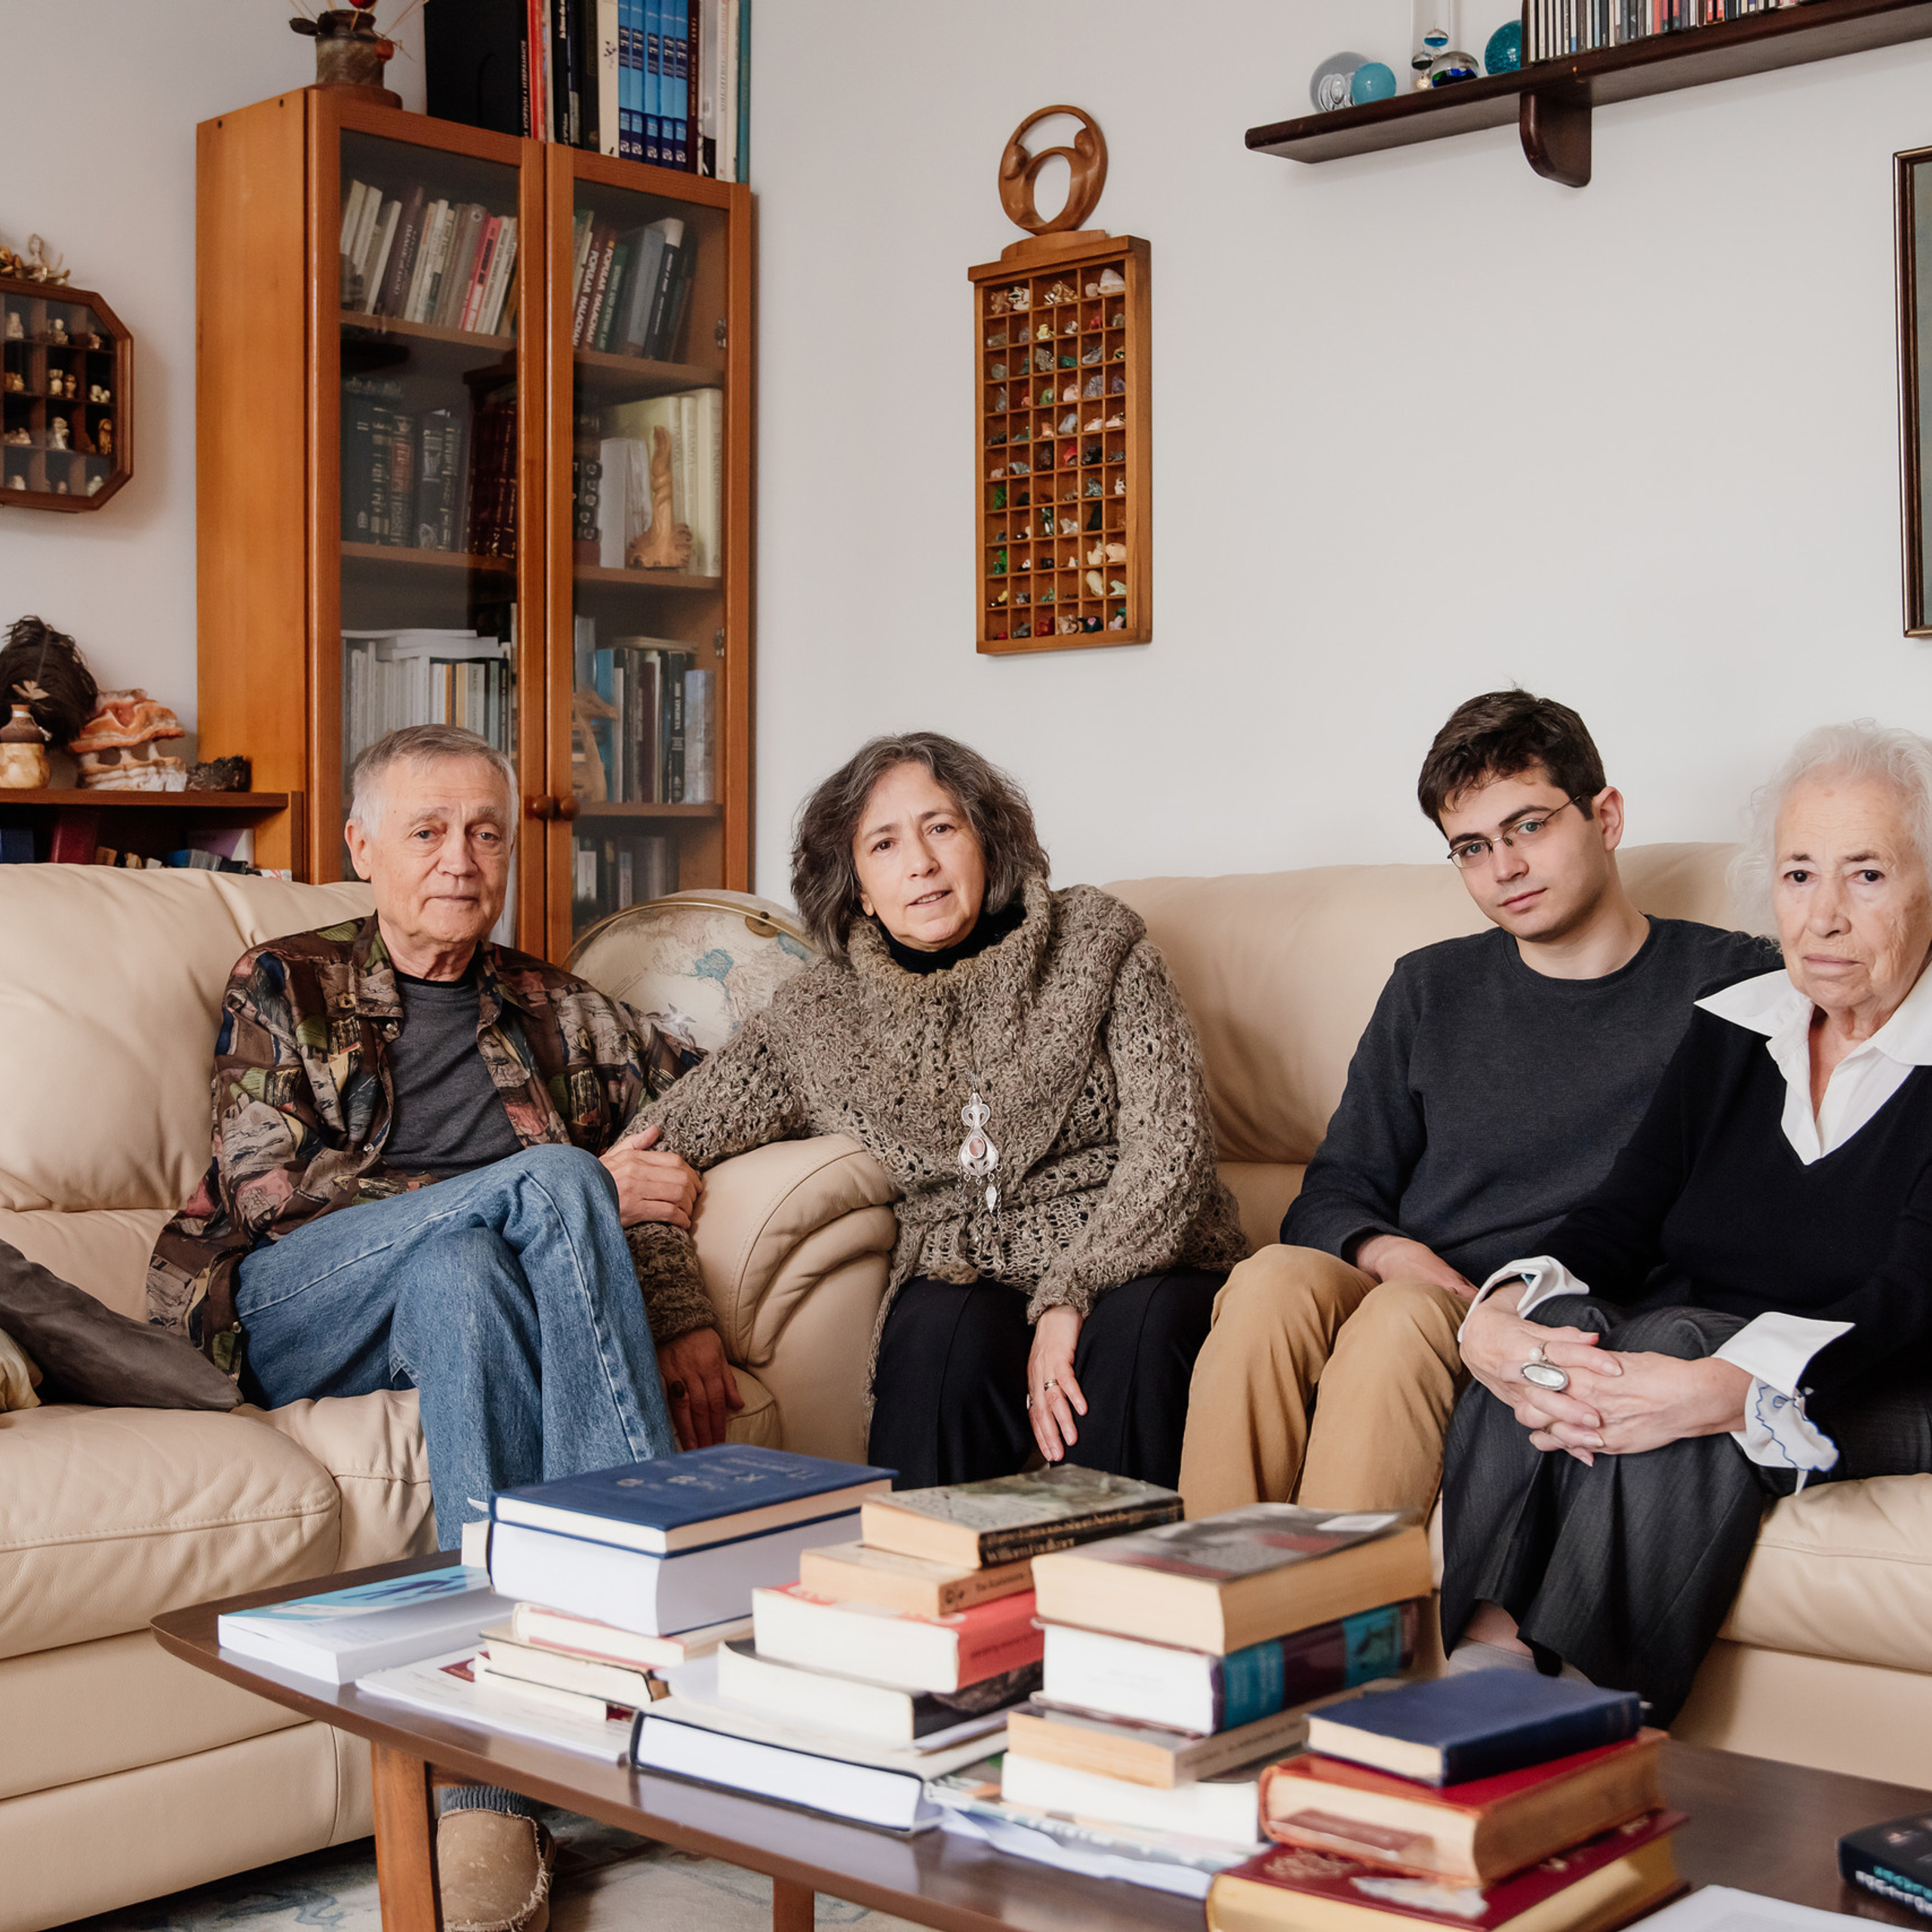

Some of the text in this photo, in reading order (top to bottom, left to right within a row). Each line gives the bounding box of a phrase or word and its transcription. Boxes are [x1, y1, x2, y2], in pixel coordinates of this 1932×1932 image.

[573, 251, 599, 346] POPULAR HALACHAH
[586, 248, 614, 343] POPULAR HALACHAH
